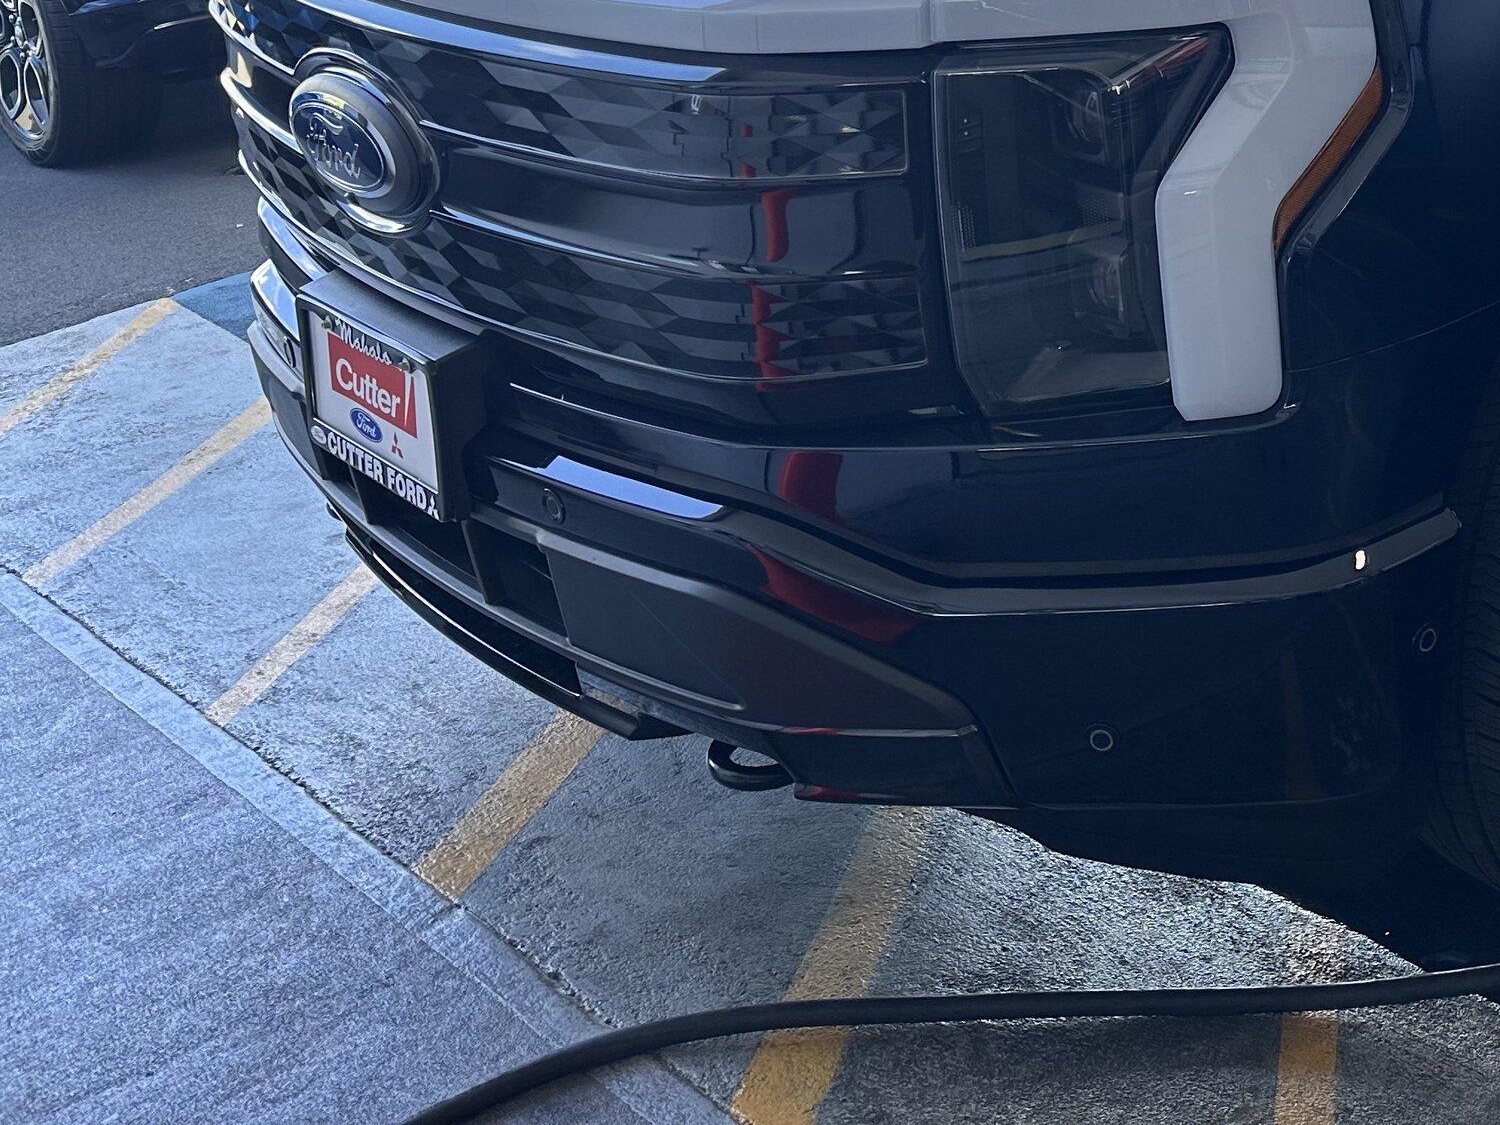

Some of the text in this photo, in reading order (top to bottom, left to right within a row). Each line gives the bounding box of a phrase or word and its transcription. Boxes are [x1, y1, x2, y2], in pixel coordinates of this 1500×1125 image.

[306, 112, 361, 180] Ford
[335, 318, 392, 365] Mahalo
[335, 358, 401, 418] Cutter
[327, 432, 427, 510] CUTTER FORD
